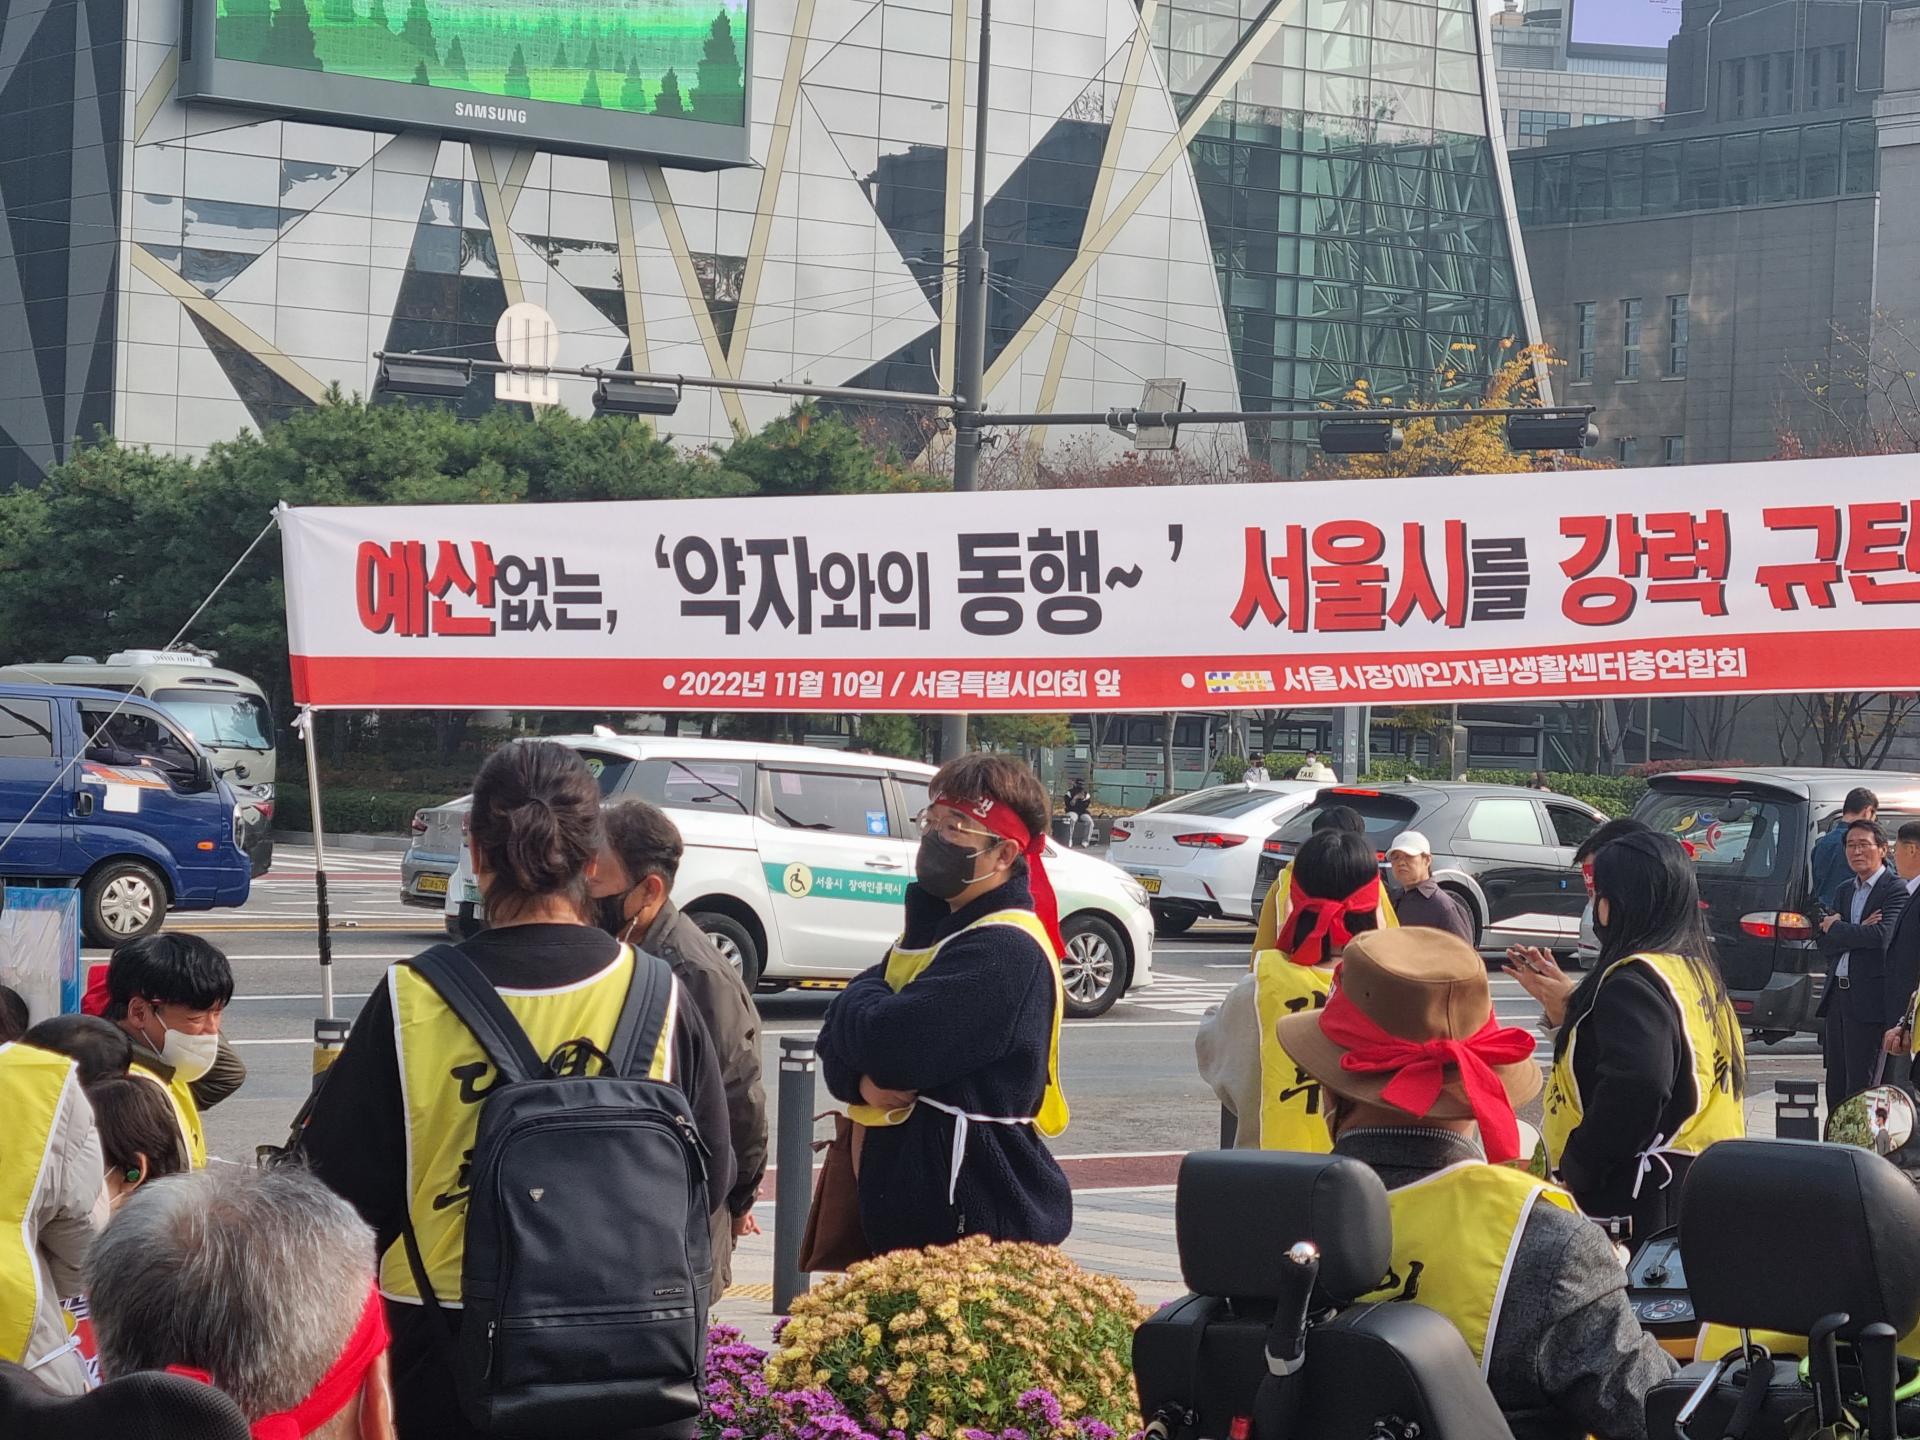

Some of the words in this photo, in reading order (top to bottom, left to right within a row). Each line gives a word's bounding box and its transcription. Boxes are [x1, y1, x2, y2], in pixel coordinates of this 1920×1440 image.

[455, 102, 527, 124] SAMSUNG
[356, 540, 618, 637] 예산없는,
[1230, 519, 1531, 633] 서울시를
[1559, 509, 1731, 627] 강력
[1283, 647, 1748, 693] 서울시장애인자립생활센터총연합회
[679, 670, 766, 697] 2022년
[774, 670, 823, 698] 11월
[831, 670, 884, 698] 10일
[910, 669, 1088, 699] 서울특별시의회
[1094, 668, 1121, 698] 앞
[1299, 770, 1315, 779] TAXI
[815, 876, 842, 891] 서울시
[848, 879, 902, 897] 장애인콜택시
